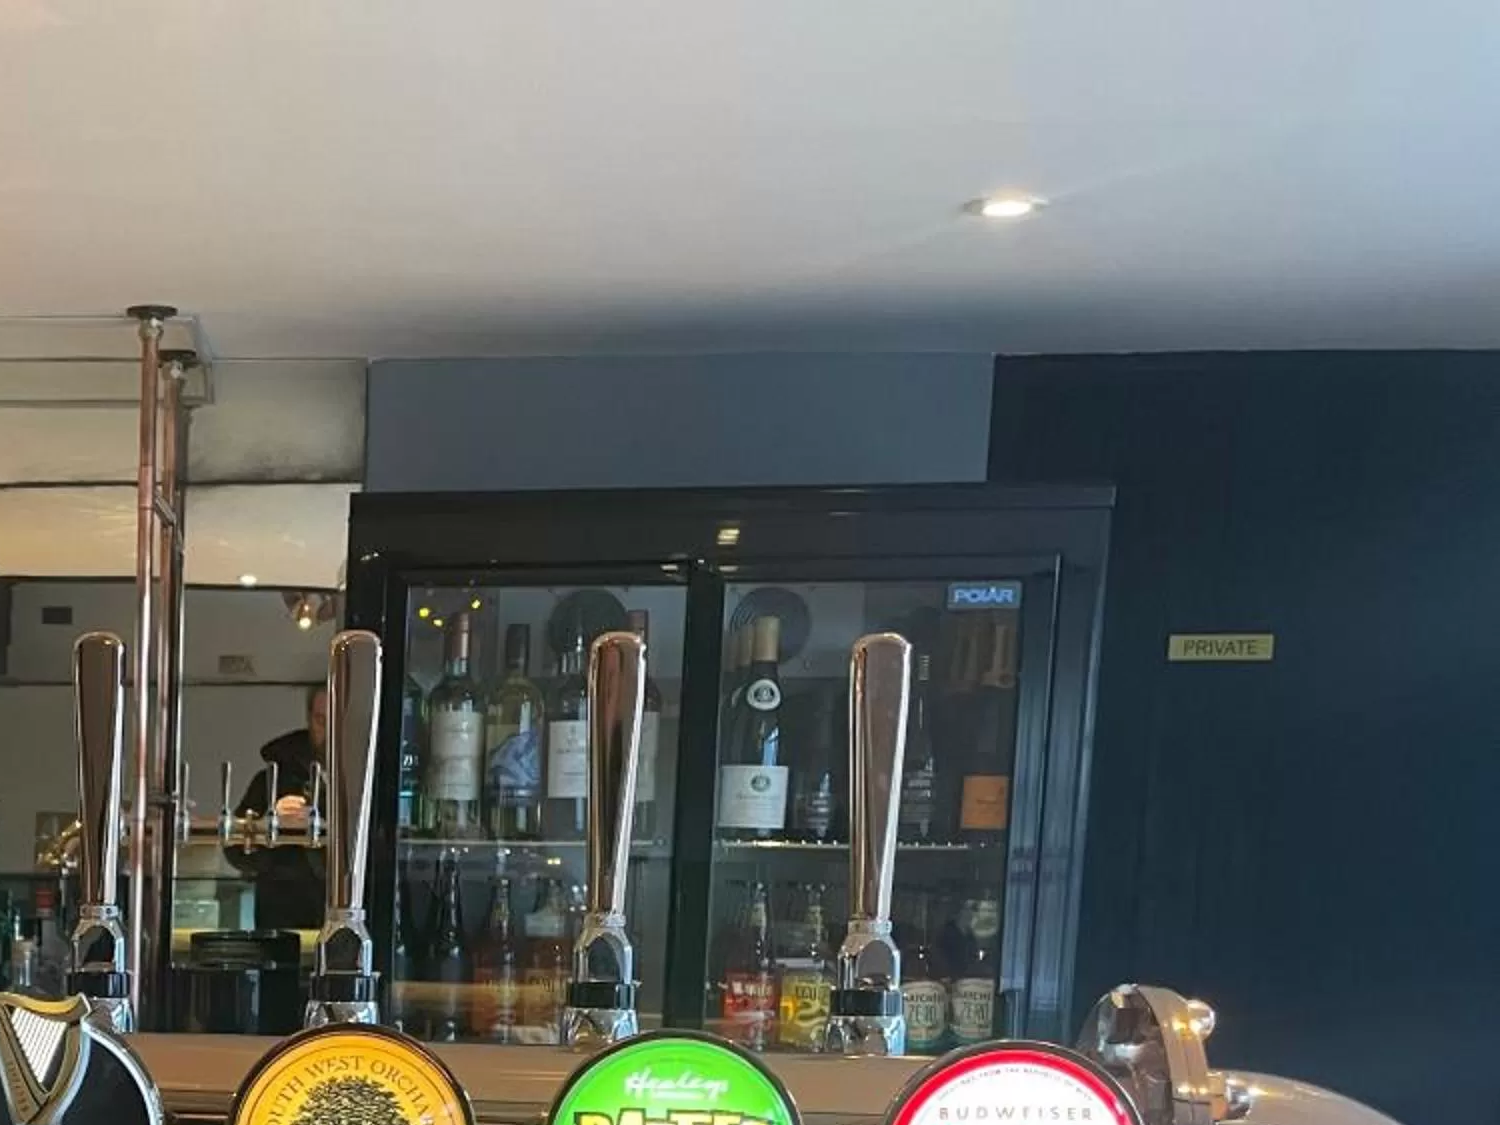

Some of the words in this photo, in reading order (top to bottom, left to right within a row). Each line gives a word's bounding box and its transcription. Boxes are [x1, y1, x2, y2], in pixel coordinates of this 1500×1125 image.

[955, 587, 1013, 603] POLAR
[1183, 639, 1258, 656] PRIVATE
[303, 1055, 365, 1079] WEST
[939, 1106, 1093, 1121] BUDWEISER
